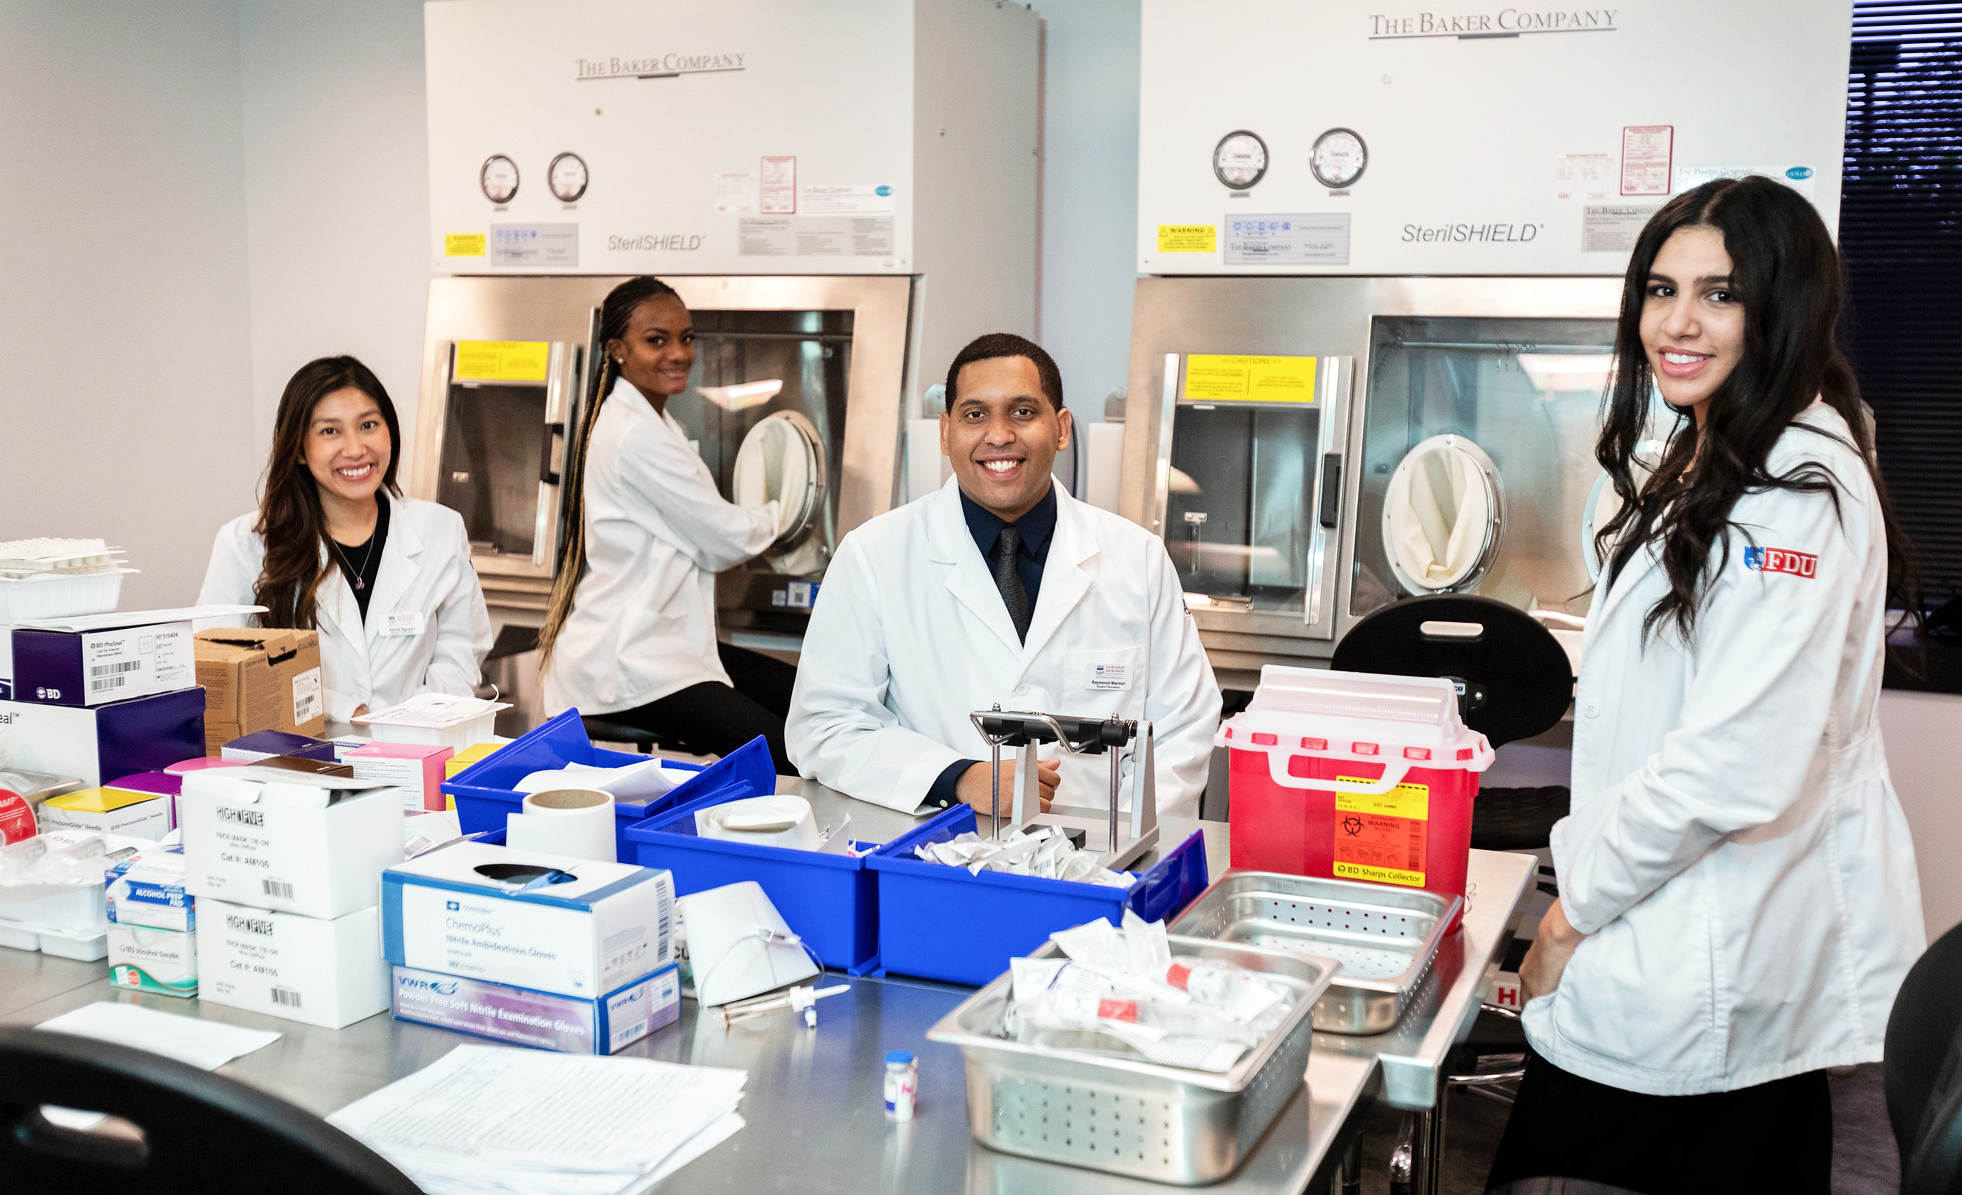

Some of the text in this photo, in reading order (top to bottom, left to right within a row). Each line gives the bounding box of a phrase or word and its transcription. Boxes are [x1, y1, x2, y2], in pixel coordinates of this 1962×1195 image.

[1369, 8, 1618, 35] THE BAKER COMPANY
[575, 52, 746, 76] THE BAKER COMPANY
[1232, 357, 1271, 365] CAUTIONS
[1766, 550, 1818, 576] FDU
[46, 688, 61, 699] BD
[216, 805, 264, 827] HIGH FIVE
[1368, 820, 1400, 830] WARNING
[216, 832, 230, 840] FACE
[220, 852, 233, 863] Cat
[244, 857, 270, 869] AM105
[1347, 866, 1421, 883] BD Sharps Collector
[135, 888, 165, 899] ALCOHOL
[166, 892, 184, 901] PREP
[169, 899, 184, 907] PAD
[225, 913, 273, 936] HIGH FIVE
[225, 939, 239, 948] FACE
[445, 934, 556, 961] Nitrile Ambidextrous Gloves
[136, 947, 158, 957] Alcohol
[159, 950, 180, 960] Swabs
[229, 959, 242, 970] Cat
[253, 965, 278, 978] AM105
[398, 975, 428, 990] VWR
[398, 988, 428, 1003] Powder
[430, 993, 449, 1007] Free
[450, 999, 469, 1012] Soft
[469, 1003, 497, 1019] Nitrile
[497, 1007, 553, 1030] Examination
[553, 1018, 585, 1036] Gloves
